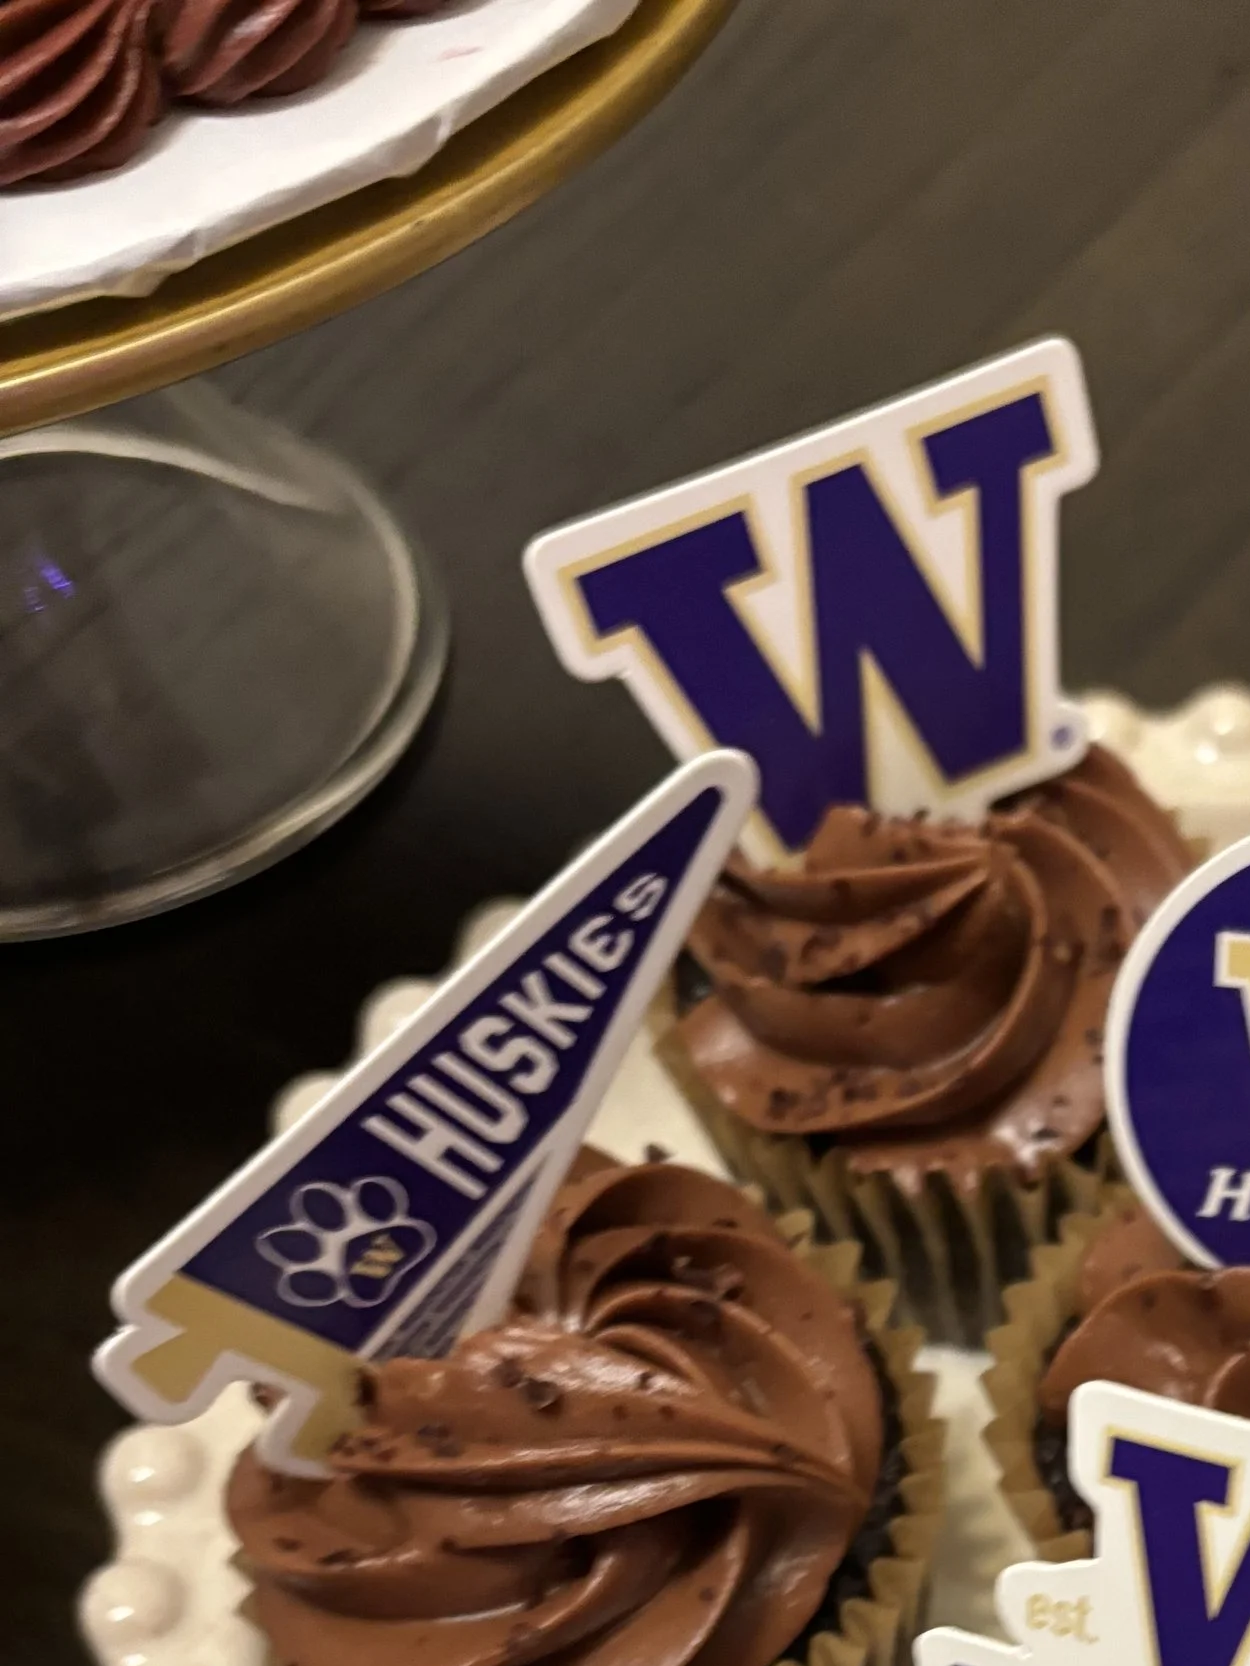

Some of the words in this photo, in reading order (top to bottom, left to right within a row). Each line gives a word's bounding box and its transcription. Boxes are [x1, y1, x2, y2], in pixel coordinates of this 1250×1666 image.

[556, 375, 1069, 867] W
[360, 873, 669, 1200] HUSKIES
[1024, 1592, 1099, 1646] est.
